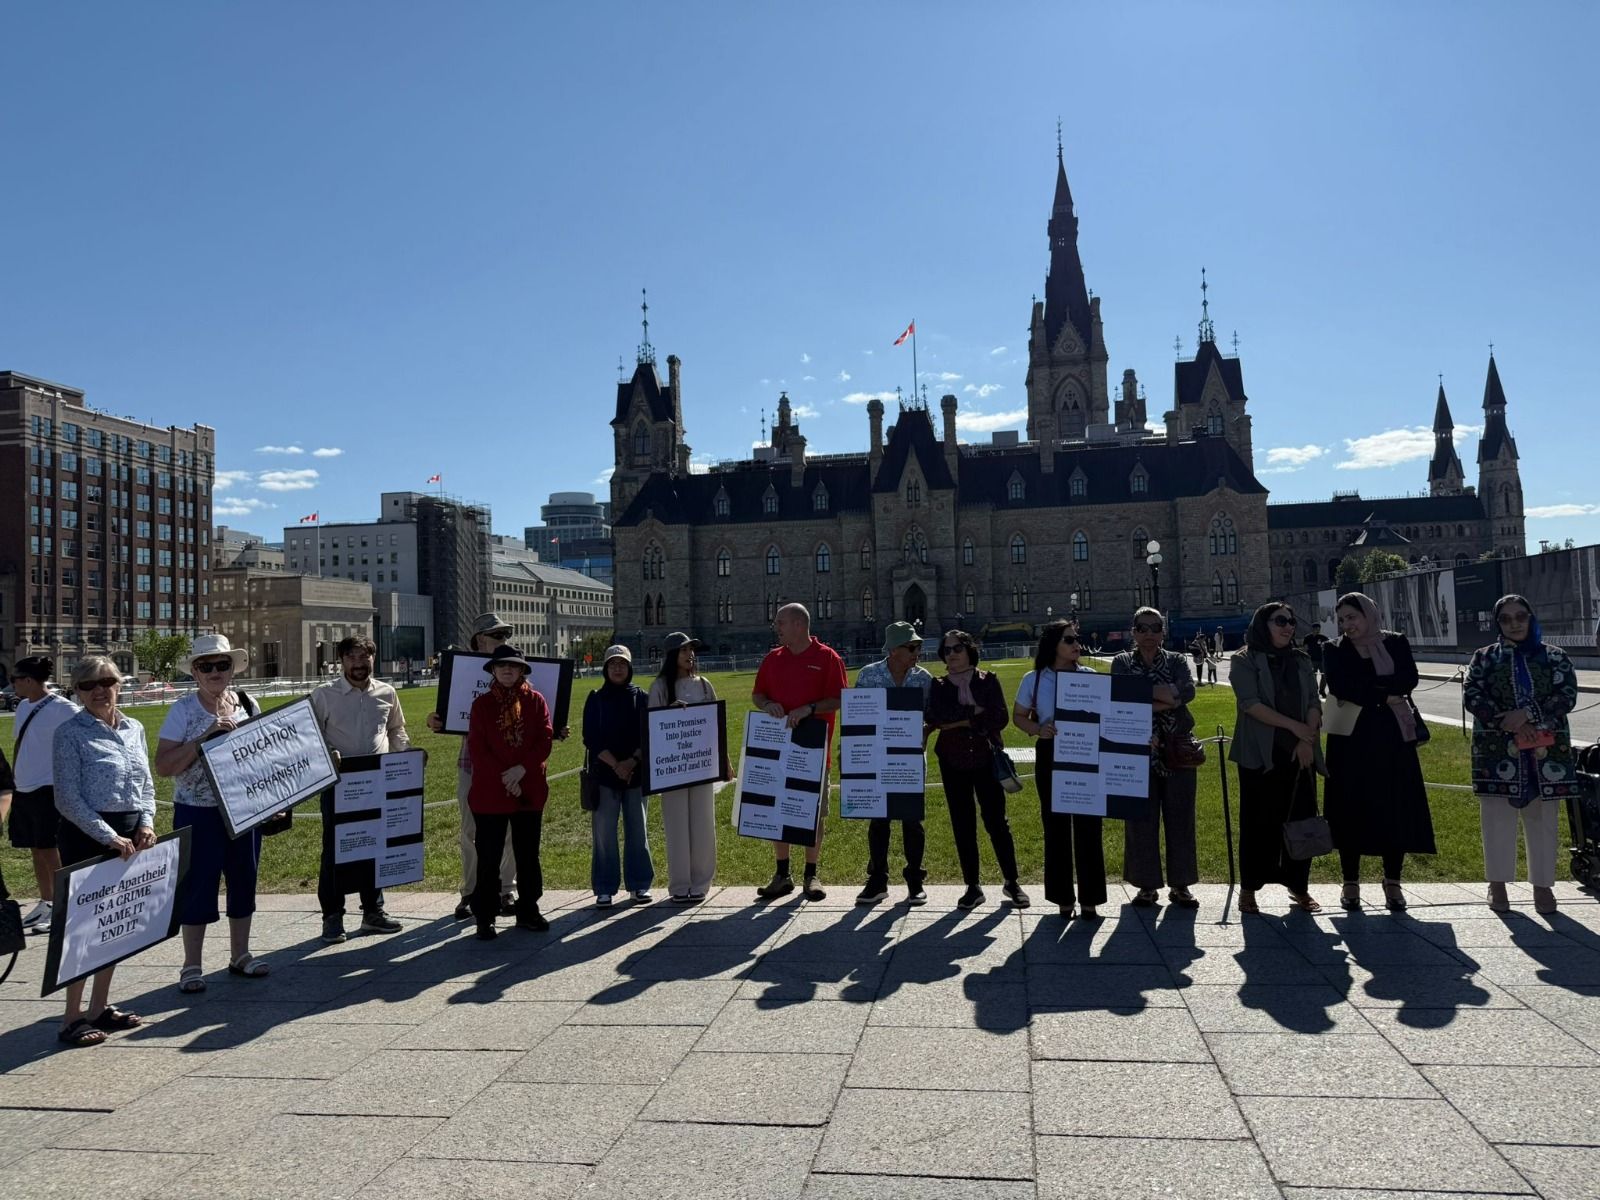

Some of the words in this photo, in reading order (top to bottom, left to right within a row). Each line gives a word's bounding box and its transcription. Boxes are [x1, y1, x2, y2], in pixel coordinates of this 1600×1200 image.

[659, 722, 676, 730] Turn
[677, 717, 706, 728] Promises
[666, 732, 679, 741] Into
[680, 728, 702, 739] Justice
[232, 724, 298, 762] EDUCATION
[677, 741, 693, 750] Take
[655, 754, 680, 765] Gender
[681, 748, 712, 761] Apartheid
[655, 768, 664, 776] To
[666, 765, 677, 774] the
[678, 763, 687, 772] ICJ
[688, 761, 700, 769] and
[701, 759, 712, 767] ICC
[246, 757, 310, 797] AFGHANISTAN
[77, 884, 116, 906] Gender
[118, 864, 167, 892] Apartheid
[94, 902, 104, 915] IS
[106, 898, 114, 910] A
[116, 885, 152, 907] CRIME
[97, 907, 131, 929] NAME
[133, 902, 145, 915] IT
[101, 925, 124, 942] END
[126, 919, 139, 932] IT
